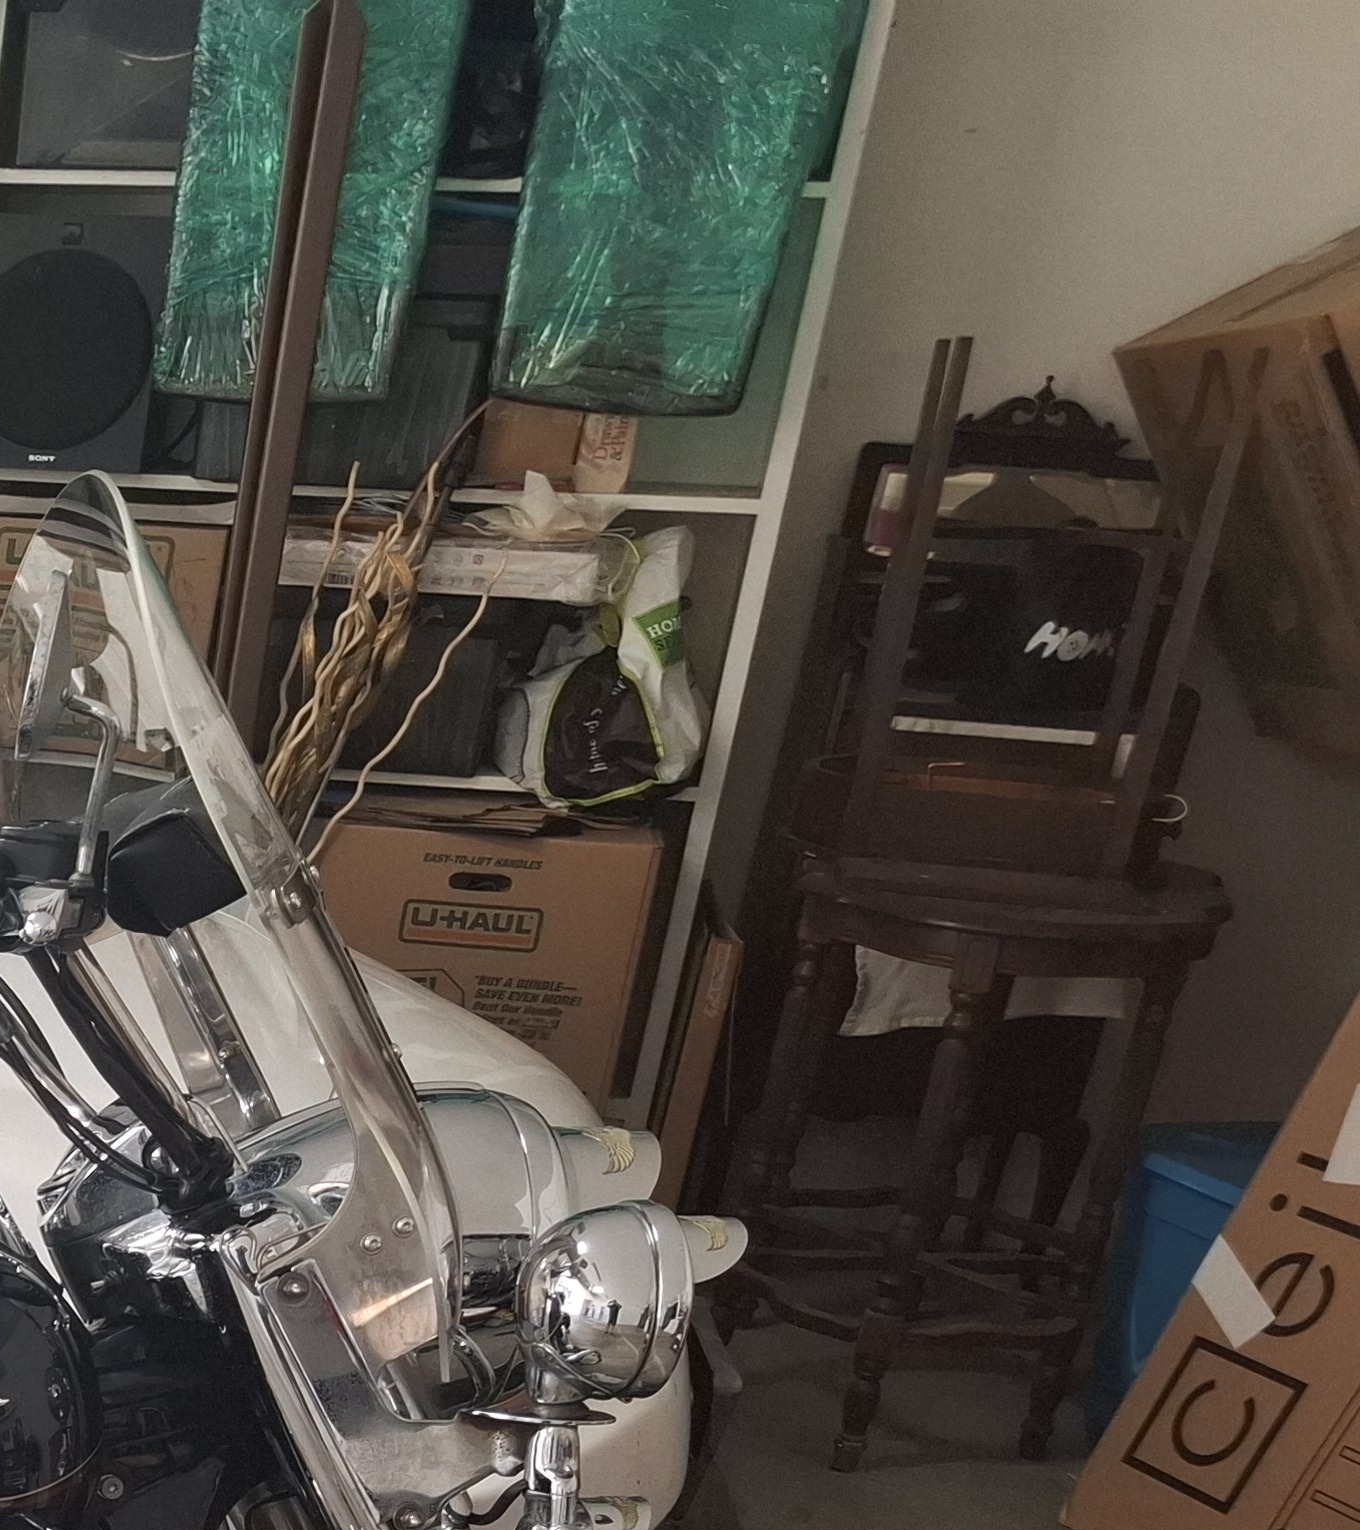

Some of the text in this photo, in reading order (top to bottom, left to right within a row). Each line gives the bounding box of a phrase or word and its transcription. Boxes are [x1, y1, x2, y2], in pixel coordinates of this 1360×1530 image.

[28, 454, 56, 462] SONY
[410, 906, 534, 935] U-HAUL
[503, 978, 513, 988] A
[474, 988, 506, 1000] SAVE
